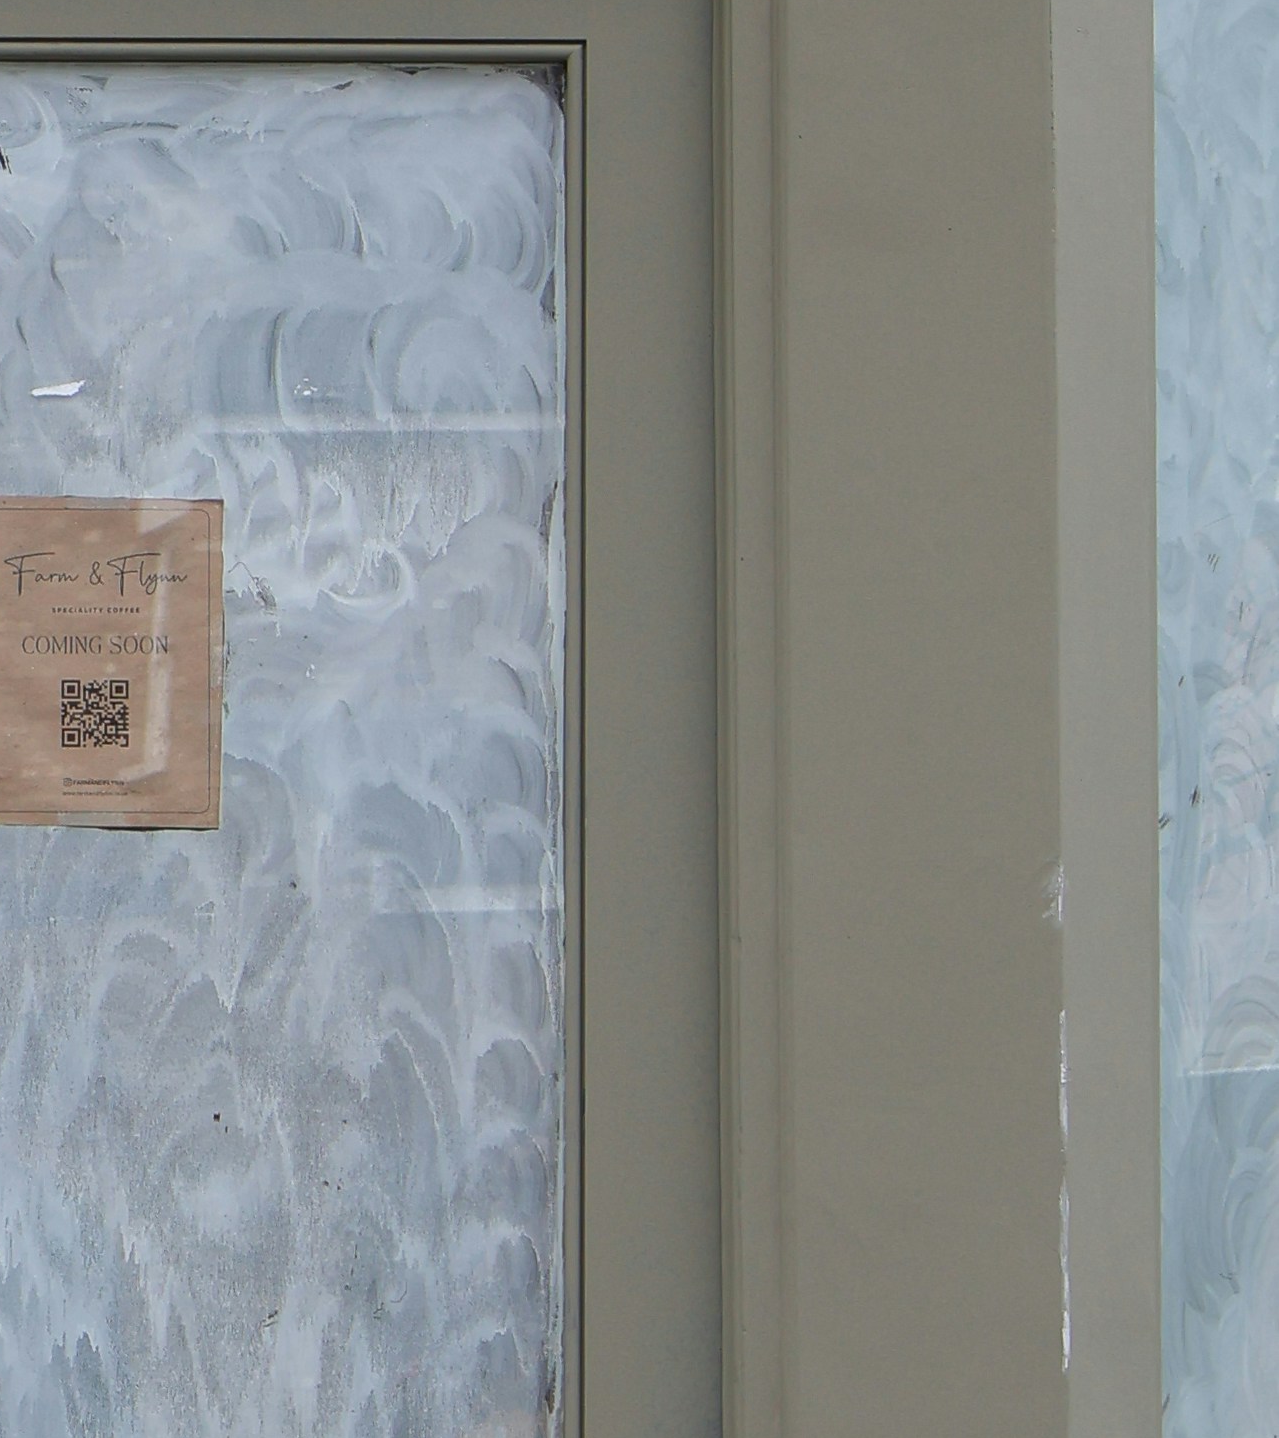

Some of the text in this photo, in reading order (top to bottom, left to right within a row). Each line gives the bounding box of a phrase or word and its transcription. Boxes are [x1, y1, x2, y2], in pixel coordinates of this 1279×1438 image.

[4, 552, 79, 597] Farm
[89, 560, 105, 586] &
[51, 606, 141, 614] SPECIALITY COFFEE
[21, 634, 170, 655] COMING SOON
